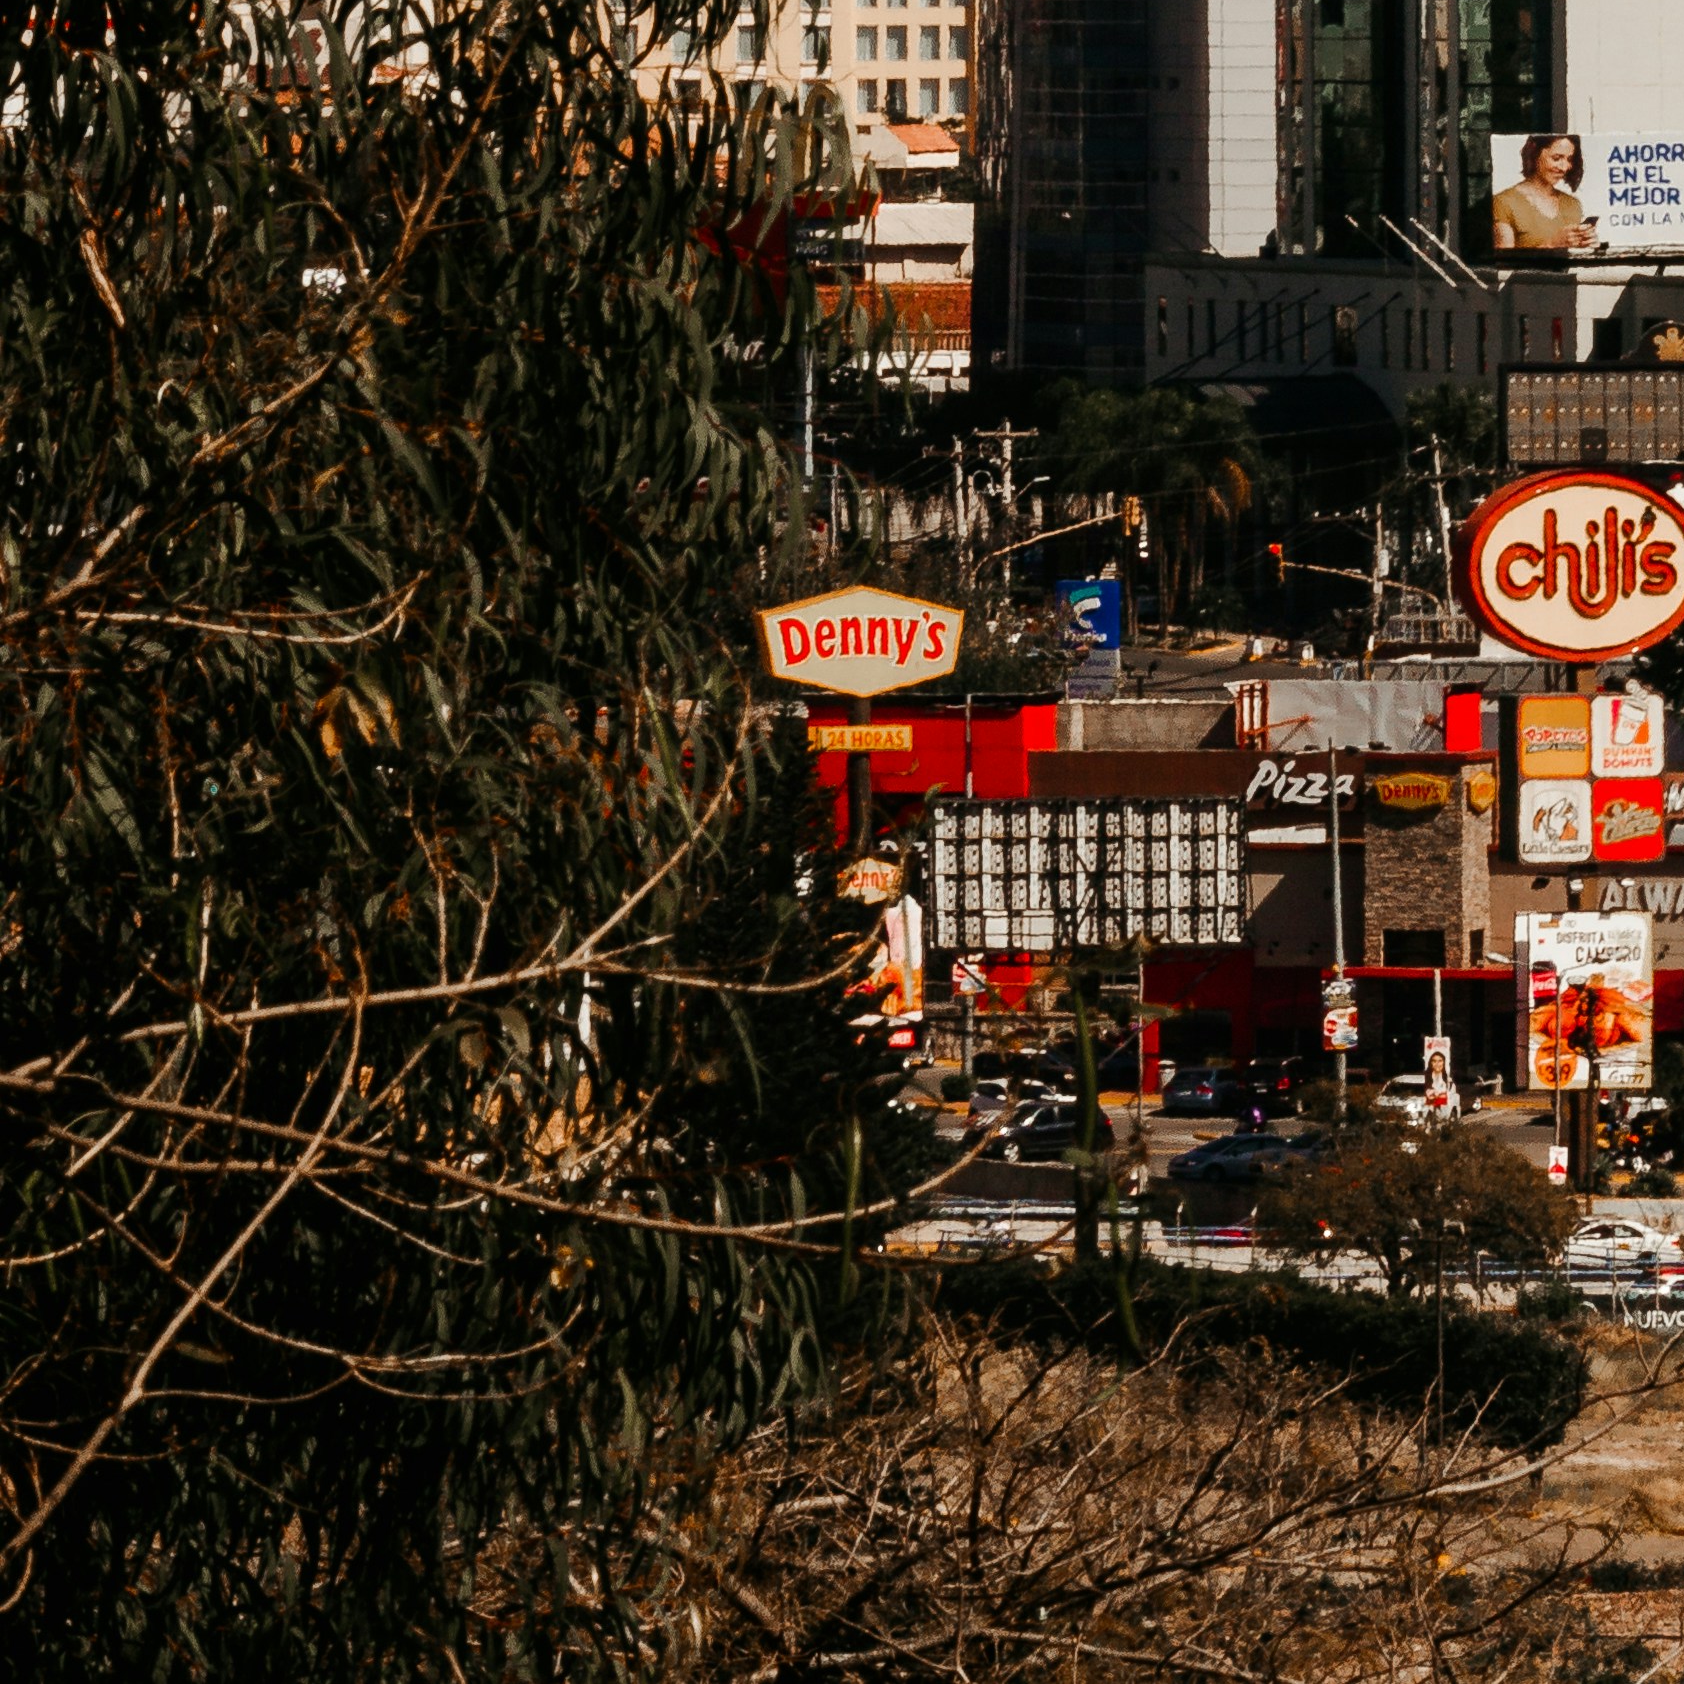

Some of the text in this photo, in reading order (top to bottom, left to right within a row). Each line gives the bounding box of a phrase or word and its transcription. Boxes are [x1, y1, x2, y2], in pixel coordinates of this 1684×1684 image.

[1608, 165, 1671, 184] EN EL
[1608, 187, 1681, 206] MEJOR
[1609, 213, 1645, 227] CON
[1651, 212, 1672, 225] LA
[1496, 505, 1678, 619] chili's
[777, 610, 948, 668] Denny's
[827, 730, 905, 748] 24 HORAS
[1246, 759, 1355, 804] Pizza
[1382, 782, 1440, 801] Denny's
